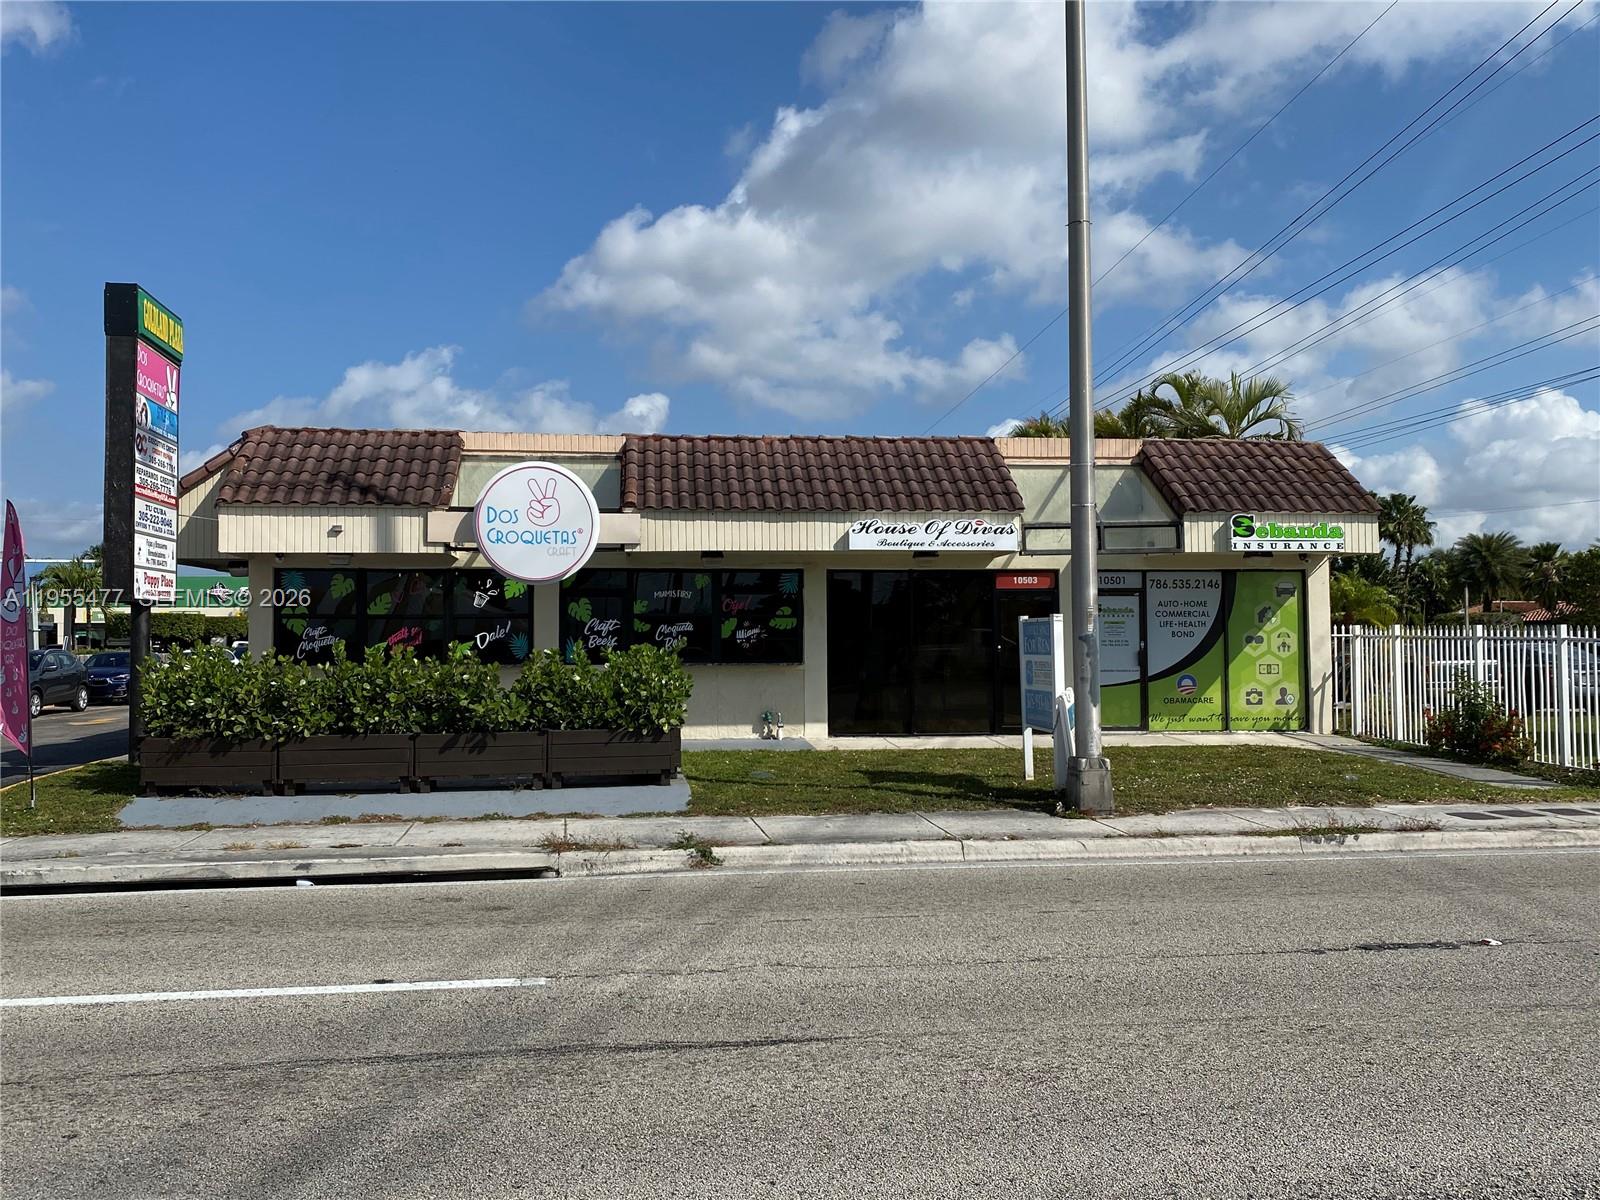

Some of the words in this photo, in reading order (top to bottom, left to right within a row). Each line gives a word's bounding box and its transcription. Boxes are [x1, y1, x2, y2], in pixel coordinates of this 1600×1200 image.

[137, 344, 148, 366] DOS
[145, 503, 152, 512] TU
[153, 506, 167, 516] CUBA
[486, 505, 519, 524] DOS
[851, 519, 917, 535] House
[924, 519, 951, 541] Of
[954, 519, 1016, 535] Divas
[1232, 514, 1344, 538] Sebanda
[877, 538, 925, 549] Boutique
[938, 539, 996, 547] Accessories
[1232, 542, 1344, 550] INSURANCE
[546, 546, 577, 557] CRAFT
[160, 574, 174, 588] Place
[1013, 576, 1038, 584] 10503
[1099, 576, 1127, 585] 10501
[1149, 578, 1220, 590] 786.535.2146
[1155, 610, 1211, 618] COMMERCIAL
[584, 617, 621, 636] Craft
[475, 620, 511, 649] Dale!
[1171, 630, 1195, 638] BOND
[1151, 713, 1164, 722] We
[1165, 713, 1188, 729] just
[1189, 714, 1216, 722] want
[1216, 714, 1225, 722] to
[1252, 716, 1270, 728] you
